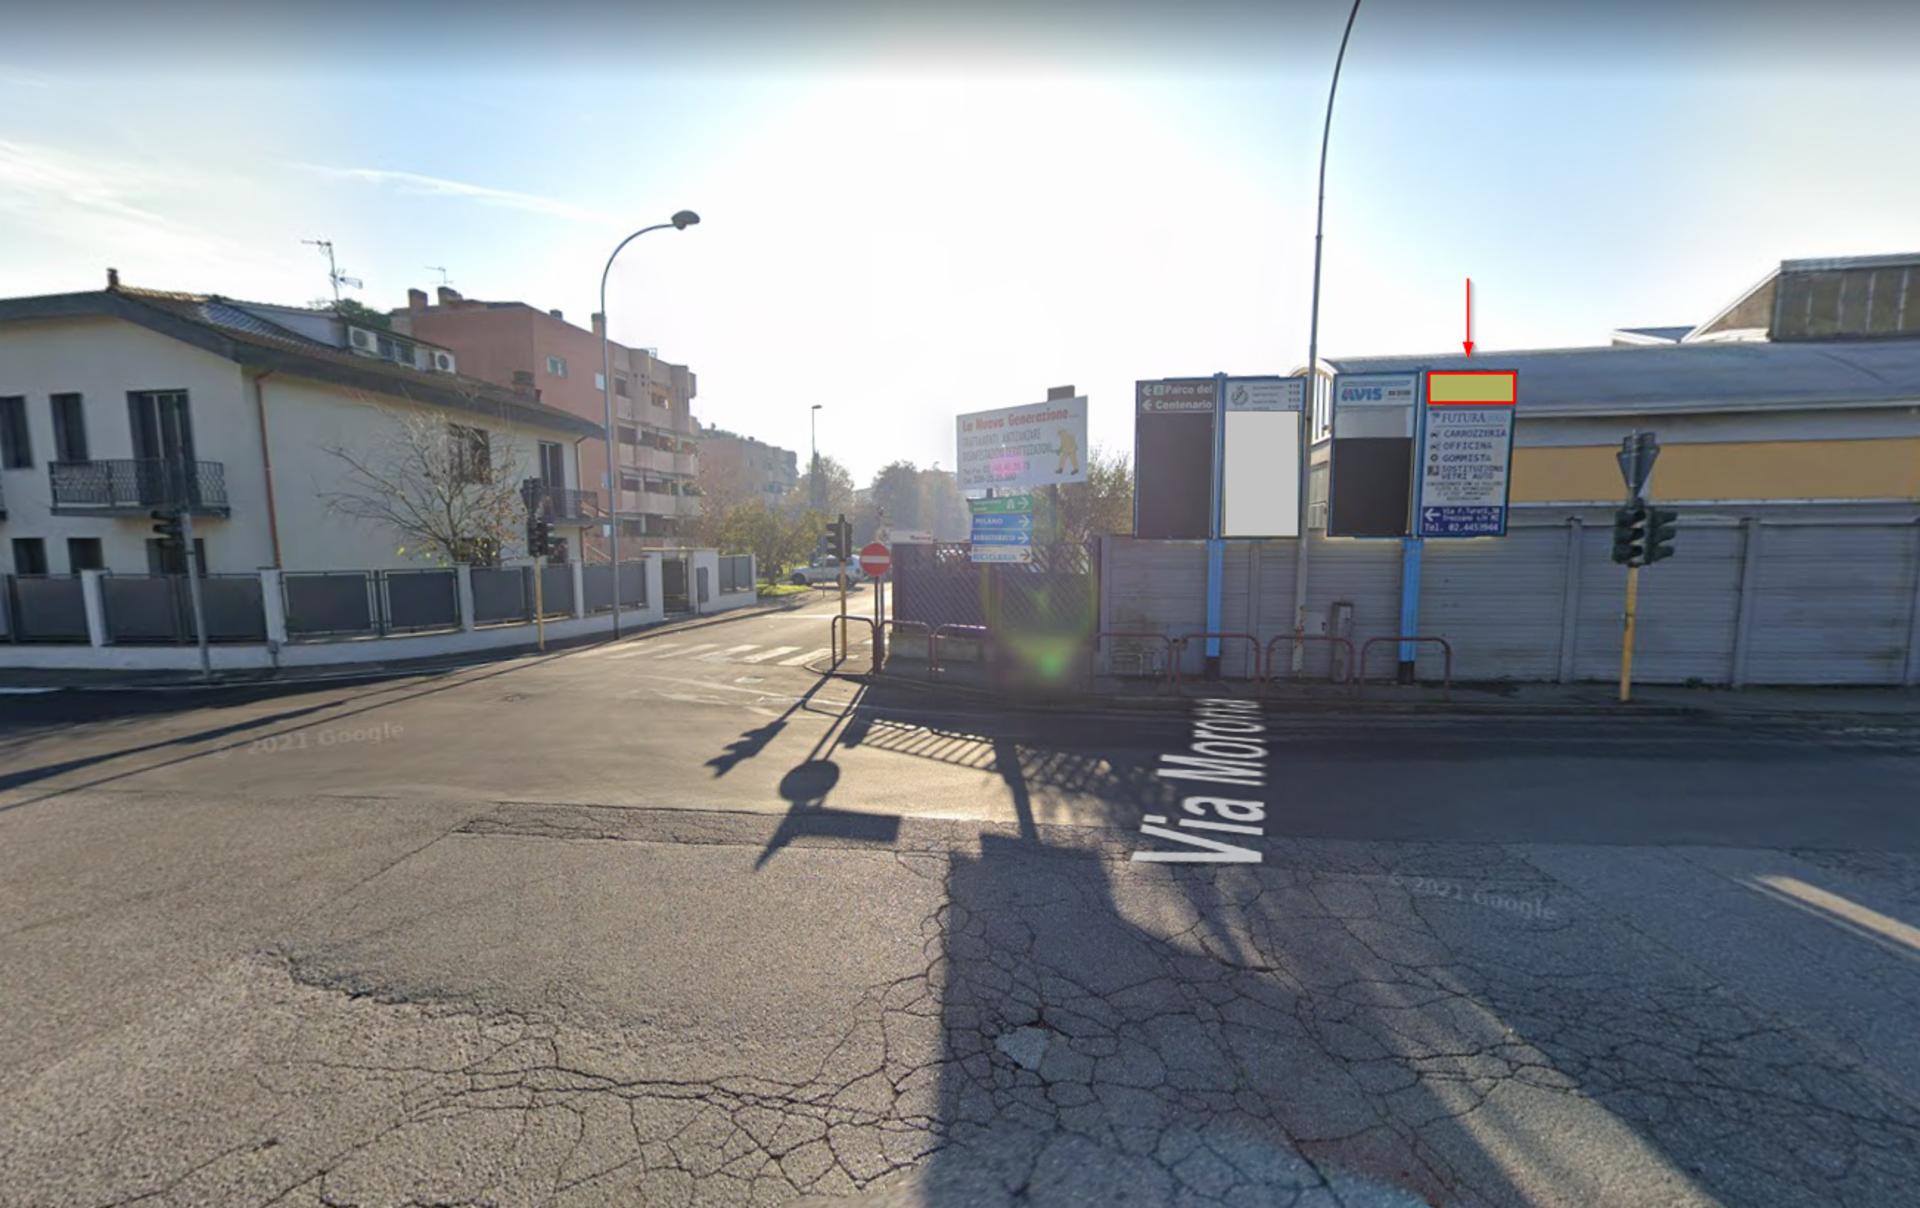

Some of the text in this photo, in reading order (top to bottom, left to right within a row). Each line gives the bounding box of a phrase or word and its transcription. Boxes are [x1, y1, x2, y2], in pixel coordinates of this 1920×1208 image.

[1165, 383, 1213, 395] Parco del
[1341, 387, 1382, 401] AVIS
[1155, 399, 1213, 410] Centenario
[1441, 412, 1486, 423] FUTURA
[1443, 429, 1507, 438] CARROZZERIA
[1442, 441, 1493, 450] OFFICINA
[1441, 454, 1493, 463] GOMMISTA
[1424, 522, 1444, 532] Tel.
